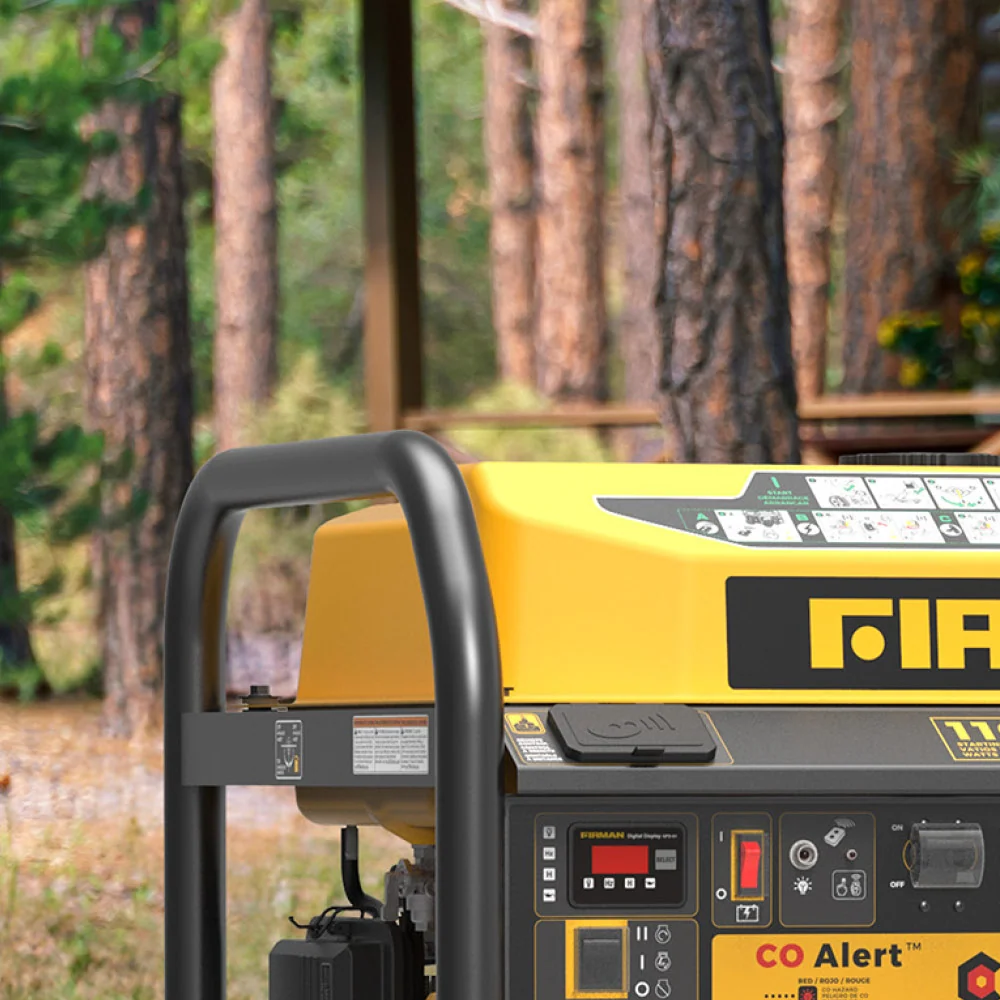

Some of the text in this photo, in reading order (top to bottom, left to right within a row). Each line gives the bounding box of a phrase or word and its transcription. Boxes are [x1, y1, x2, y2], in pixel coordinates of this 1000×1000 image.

[891, 824, 903, 832] ON
[580, 831, 625, 839] FIRMAN
[890, 881, 905, 889] OFF
[756, 943, 804, 968] CO
